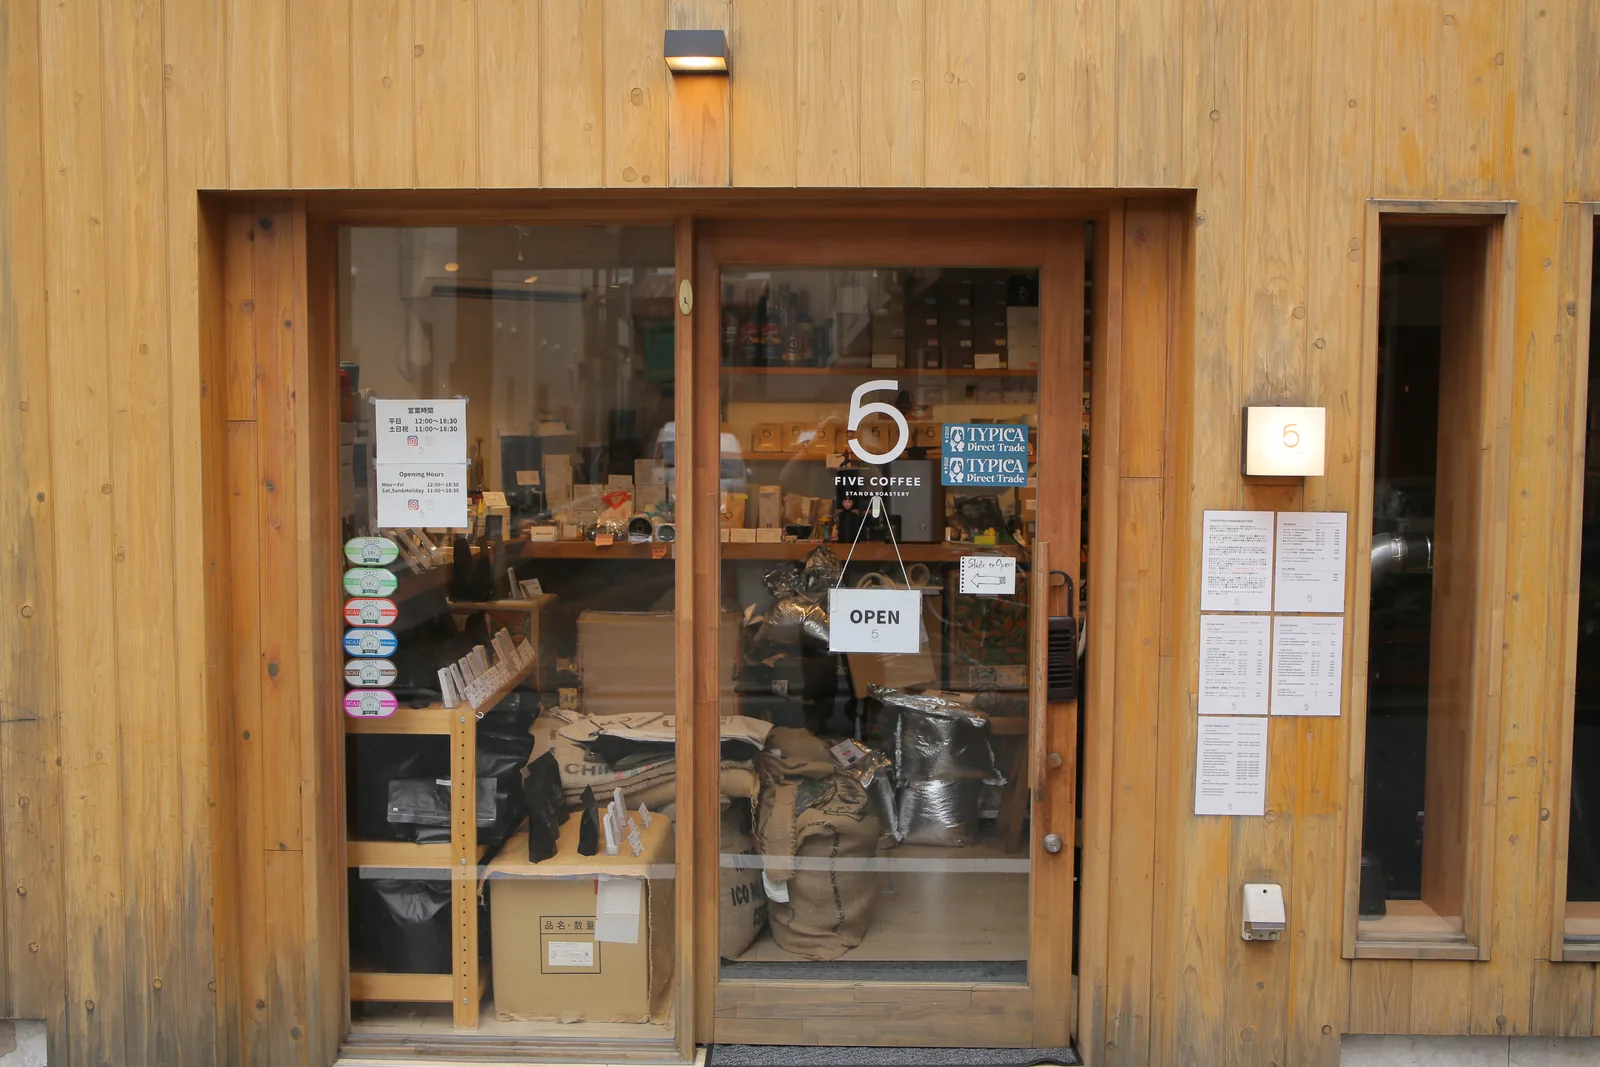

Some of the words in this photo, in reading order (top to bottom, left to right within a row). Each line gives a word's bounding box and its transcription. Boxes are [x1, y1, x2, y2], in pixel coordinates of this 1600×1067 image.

[967, 427, 1025, 442] TYPICA
[967, 442, 996, 451] Direct
[998, 442, 1026, 452] Trade
[966, 458, 1024, 473] TYPICA
[834, 477, 865, 486] FIVE
[870, 477, 921, 487] COFFEE
[966, 474, 995, 482] Direct
[997, 474, 1025, 483] Trade
[968, 558, 986, 568] Slide
[996, 558, 1012, 571] Open
[850, 609, 899, 624] OPEN
